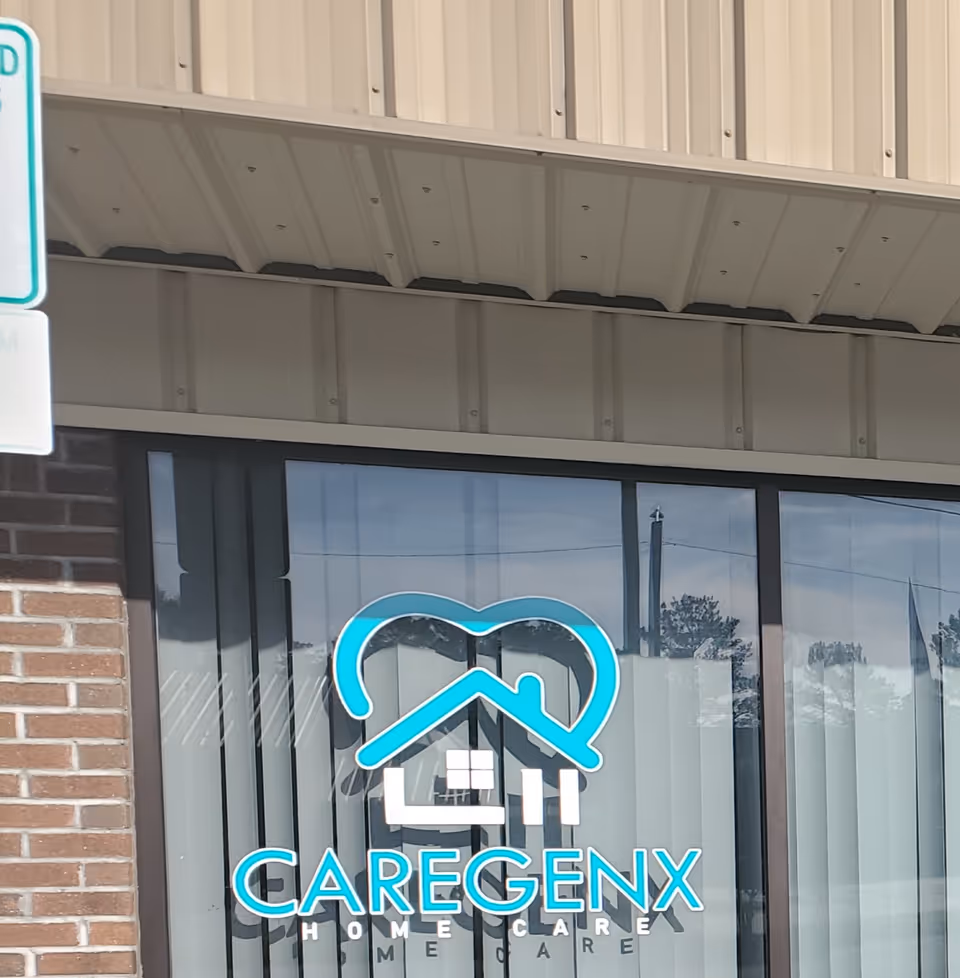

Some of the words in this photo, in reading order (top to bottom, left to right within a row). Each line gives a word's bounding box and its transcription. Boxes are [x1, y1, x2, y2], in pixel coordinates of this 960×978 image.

[232, 847, 704, 917] CAREGENX
[301, 920, 452, 940] HOME
[512, 917, 651, 938] CARE
